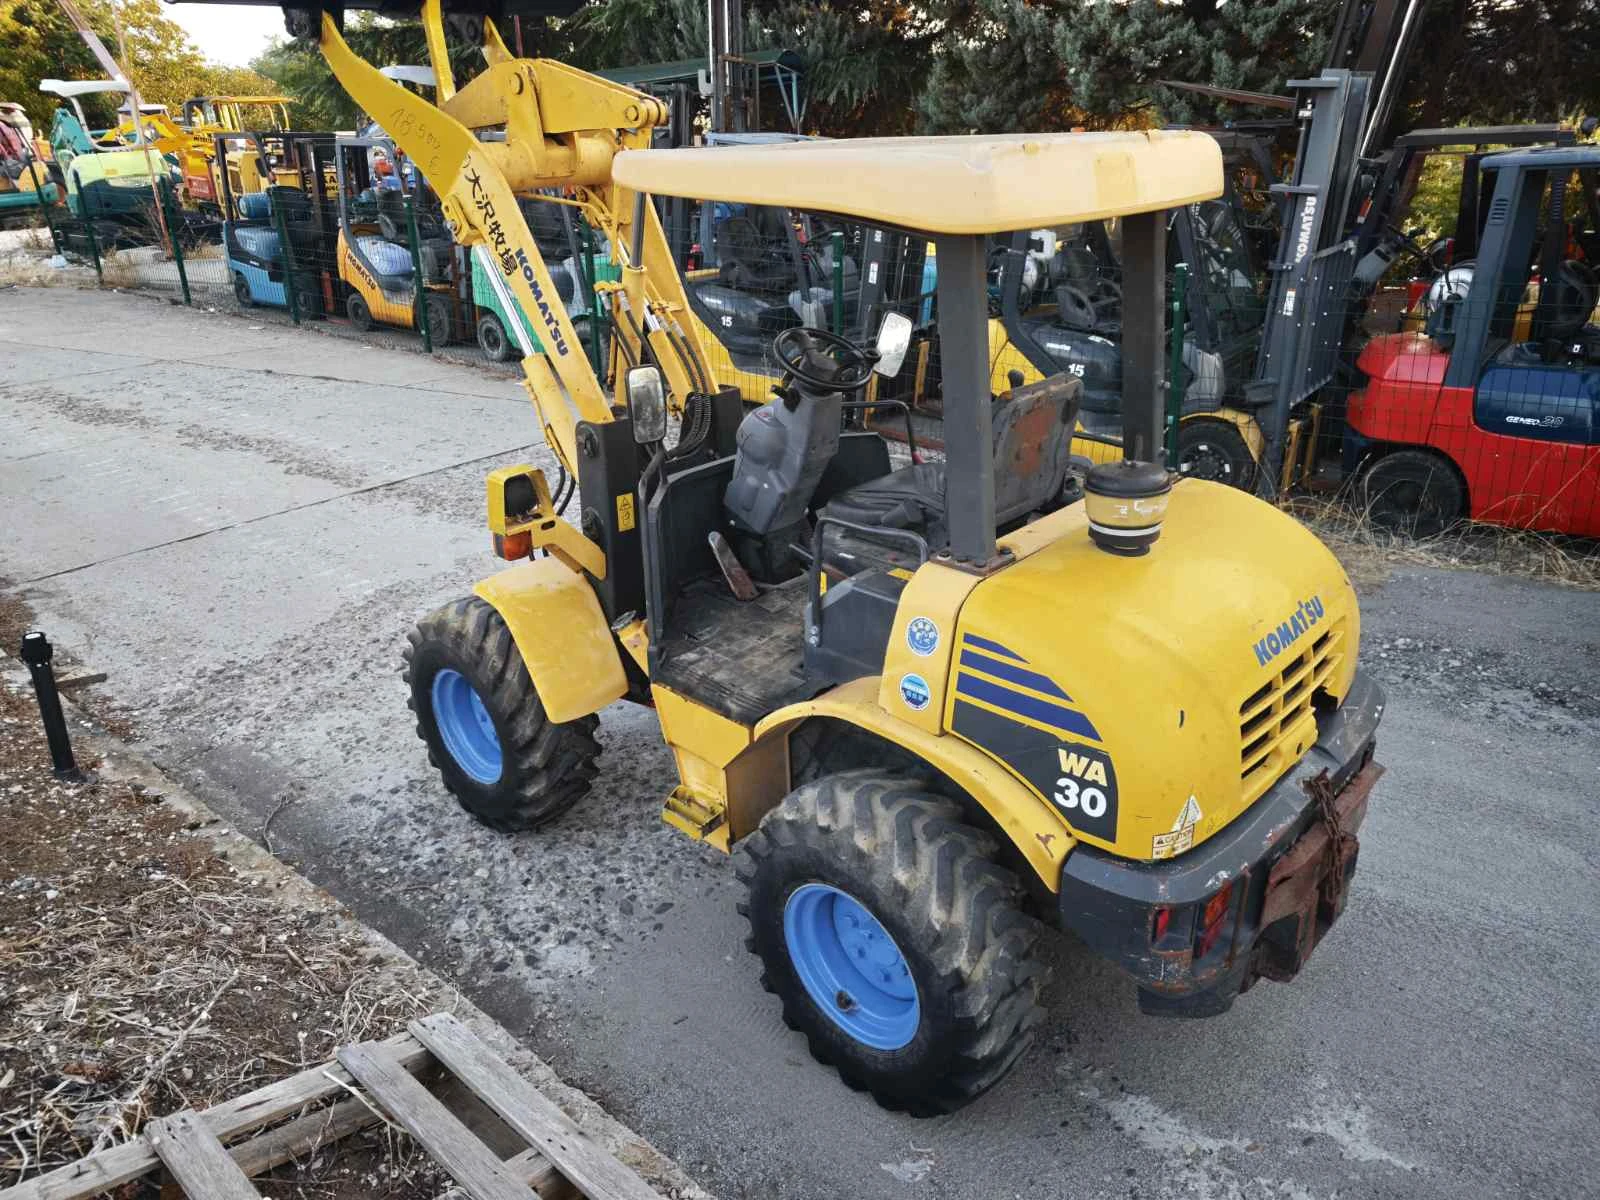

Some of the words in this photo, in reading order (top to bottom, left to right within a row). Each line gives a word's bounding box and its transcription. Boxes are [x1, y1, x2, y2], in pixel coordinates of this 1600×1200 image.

[1295, 196, 1317, 263] KOMATSU
[347, 252, 377, 290] KOMATSU
[516, 247, 569, 357] KOMATSU
[721, 315, 733, 327] 15
[1068, 363, 1085, 377] 15
[1254, 596, 1324, 666] KOMATSU
[1058, 749, 1107, 786] WA
[1054, 778, 1106, 817] 30
